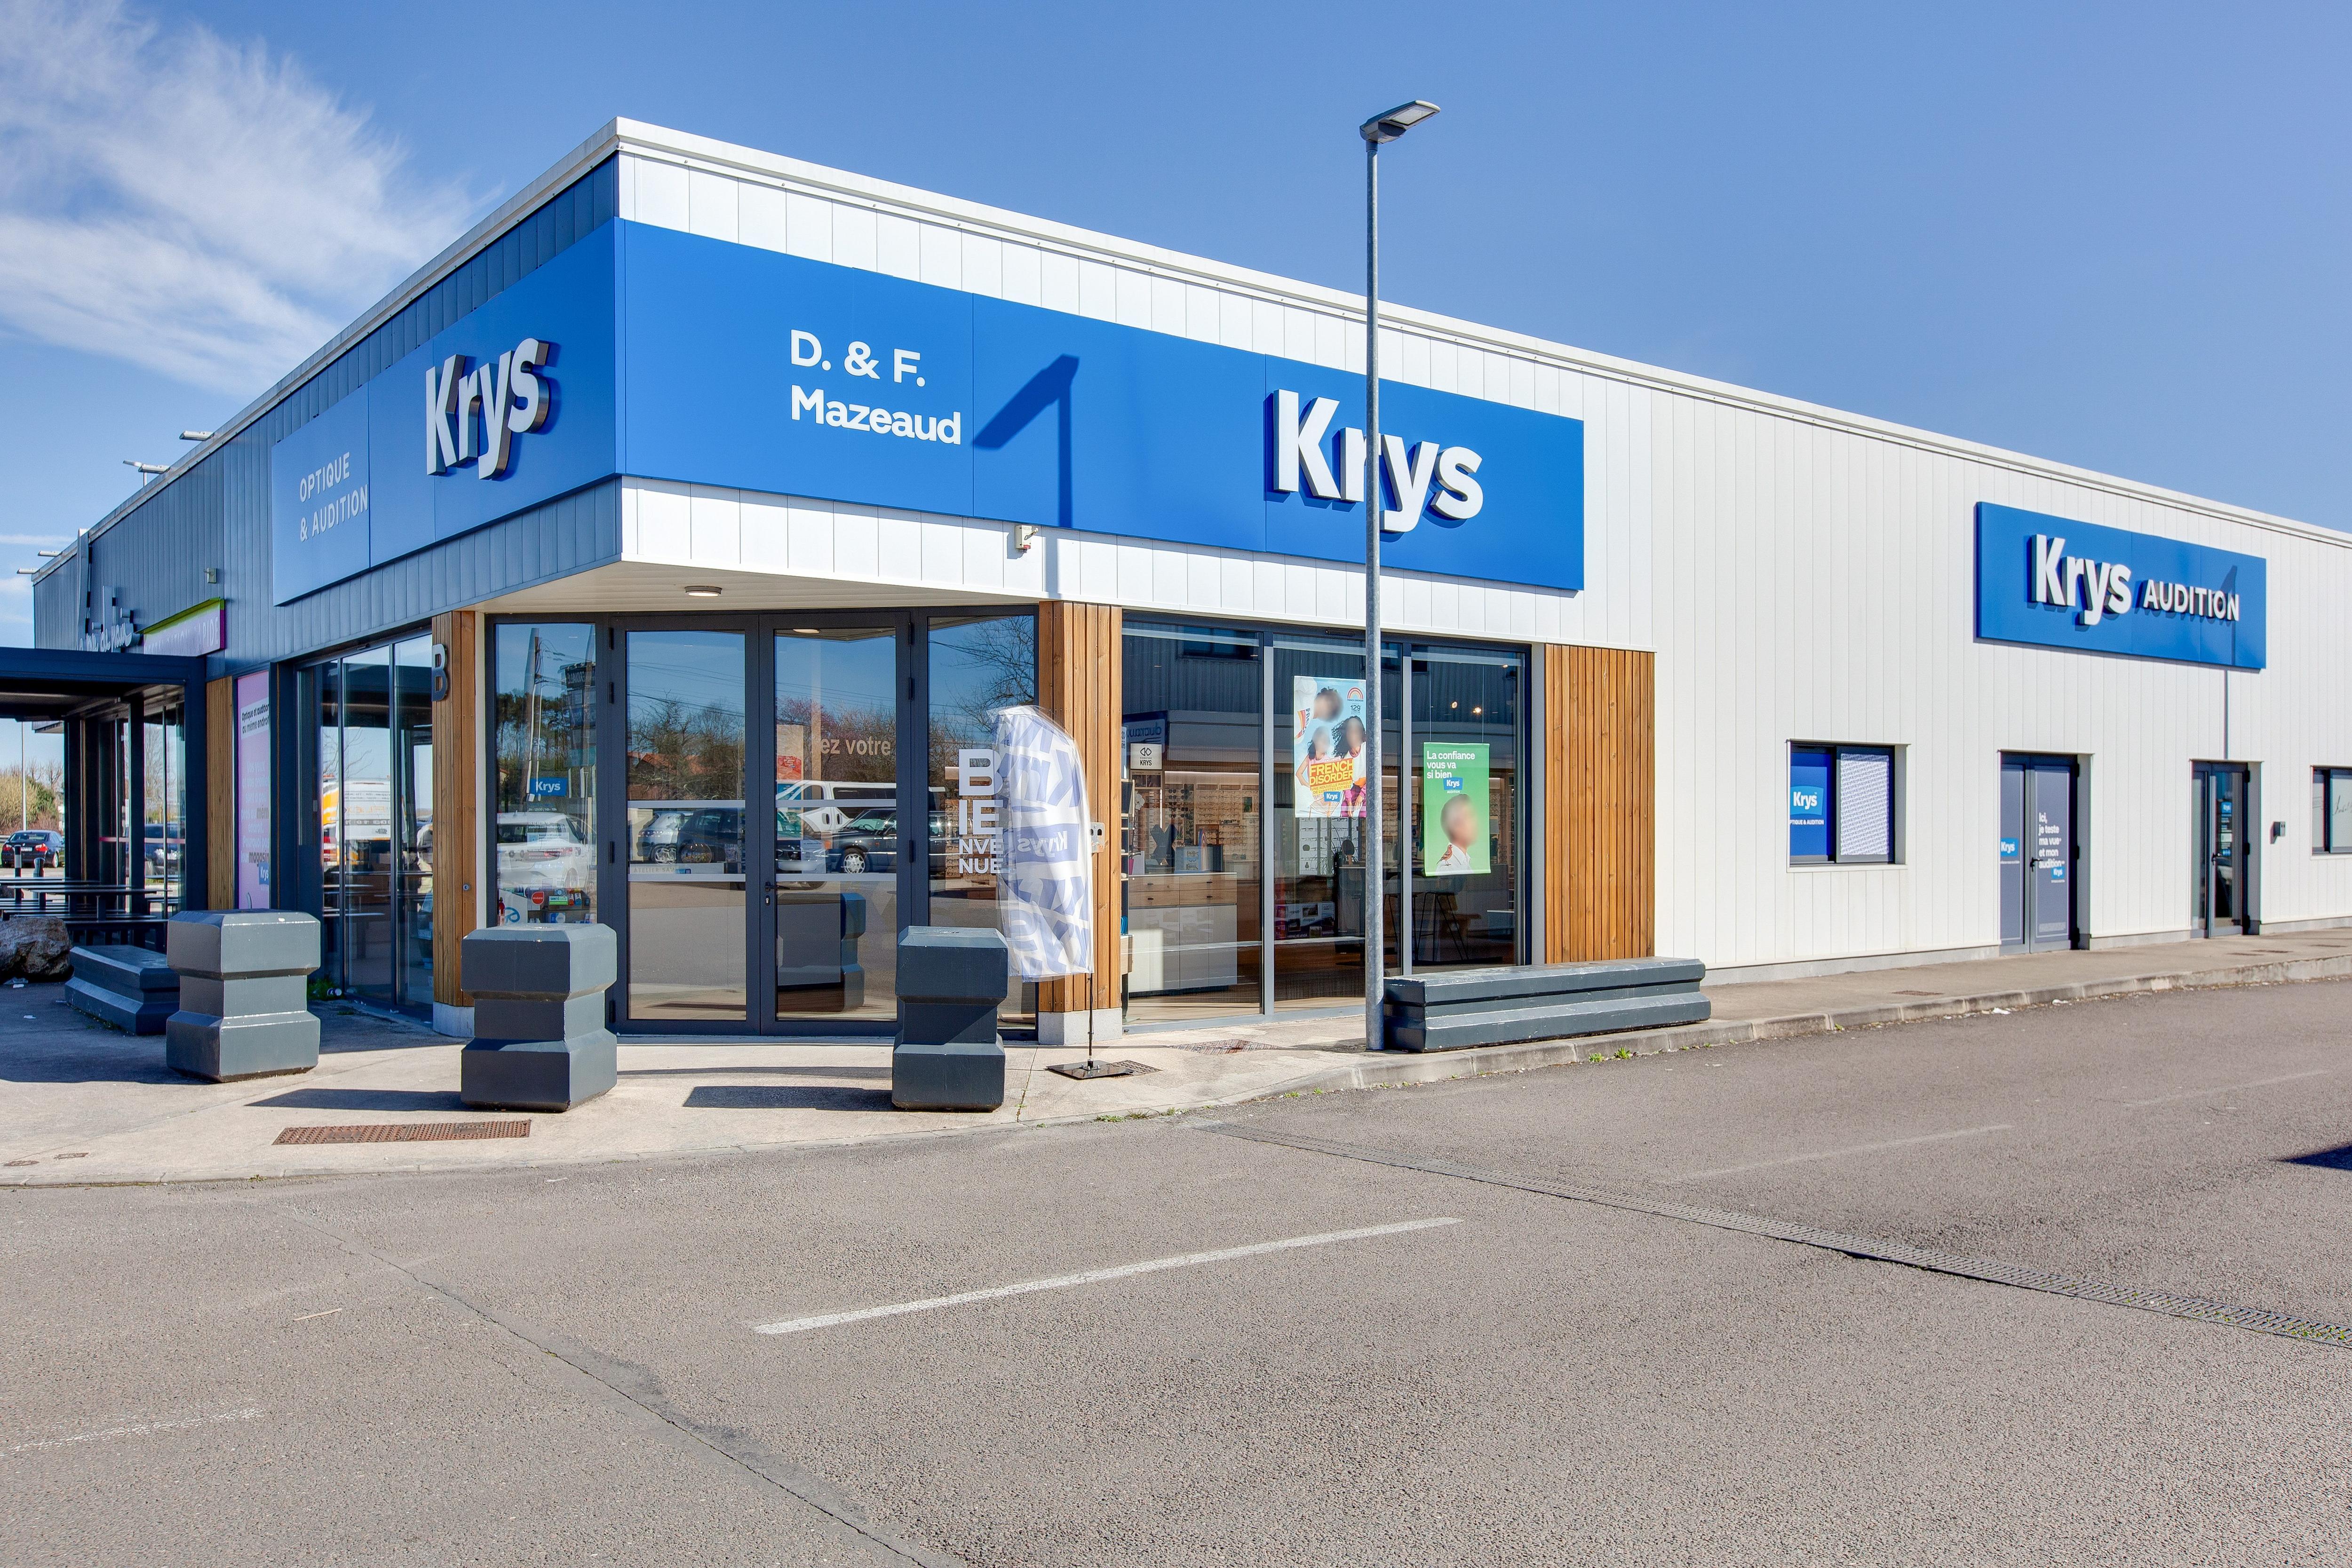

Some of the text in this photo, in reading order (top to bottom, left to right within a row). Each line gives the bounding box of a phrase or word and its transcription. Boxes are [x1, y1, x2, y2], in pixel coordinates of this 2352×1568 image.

[791, 329, 925, 387] D. & F.
[425, 337, 549, 480] Krys
[791, 384, 961, 445] Mazeaud
[1273, 389, 1484, 533] Krys
[300, 452, 350, 503] OPTIQUE
[300, 484, 368, 542] & AUDITION
[2031, 533, 2240, 626] Krys AUDITION
[432, 643, 447, 701] B
[242, 710, 253, 723] Optique
[821, 736, 891, 756] ez votre
[1427, 750, 1475, 760] La confiance
[959, 749, 1003, 796] B
[1309, 759, 1354, 776] FRENCH
[1426, 770, 1452, 779] si bien
[1310, 770, 1354, 786] DISORDER
[1446, 780, 1460, 788] Krys
[536, 781, 560, 793] Krys
[1793, 791, 1818, 810] Krys
[959, 800, 1003, 835] IE
[2039, 812, 2048, 824] Ici,
[2038, 824, 2060, 836] je teste
[959, 839, 1003, 854] NVE
[2001, 842, 2015, 854] Krys
[2039, 848, 2059, 857] et mon
[260, 866, 269, 881] Krys
[959, 858, 1004, 874] NUE
